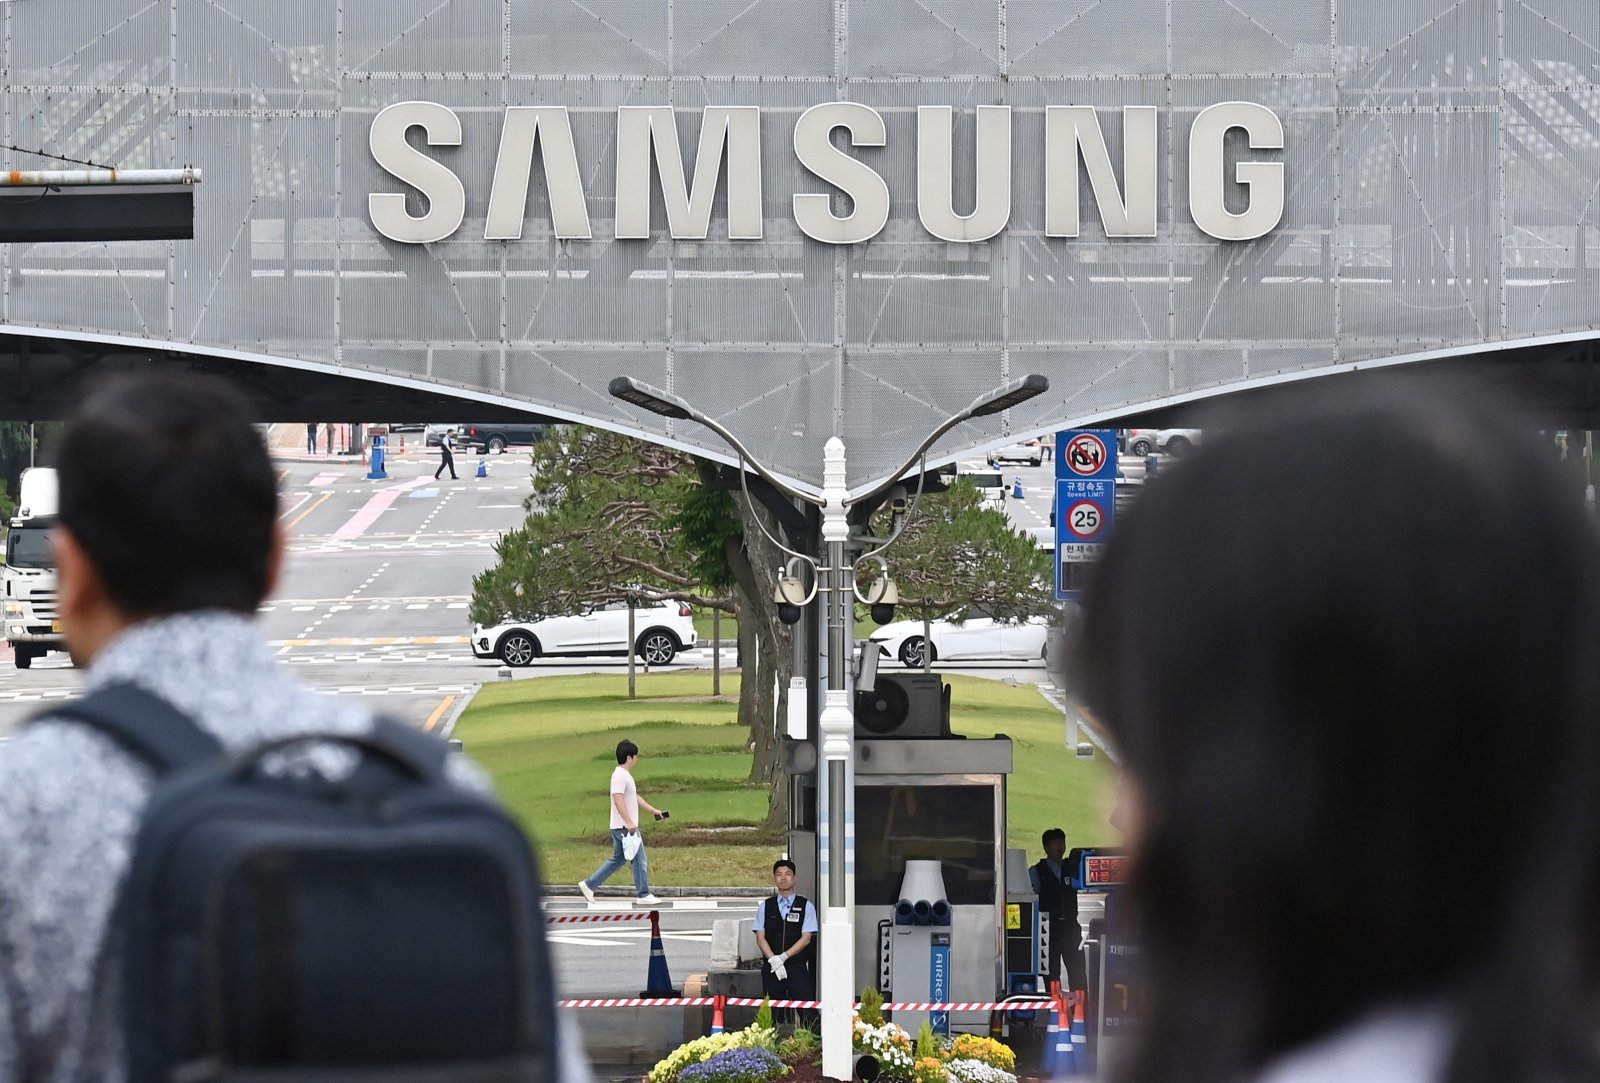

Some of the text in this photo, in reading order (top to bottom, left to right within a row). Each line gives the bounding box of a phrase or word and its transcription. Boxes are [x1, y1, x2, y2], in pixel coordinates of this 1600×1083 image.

[369, 101, 1285, 244] SAMSUNG
[1067, 482, 1104, 491] 규정속도
[1075, 510, 1097, 527] 25
